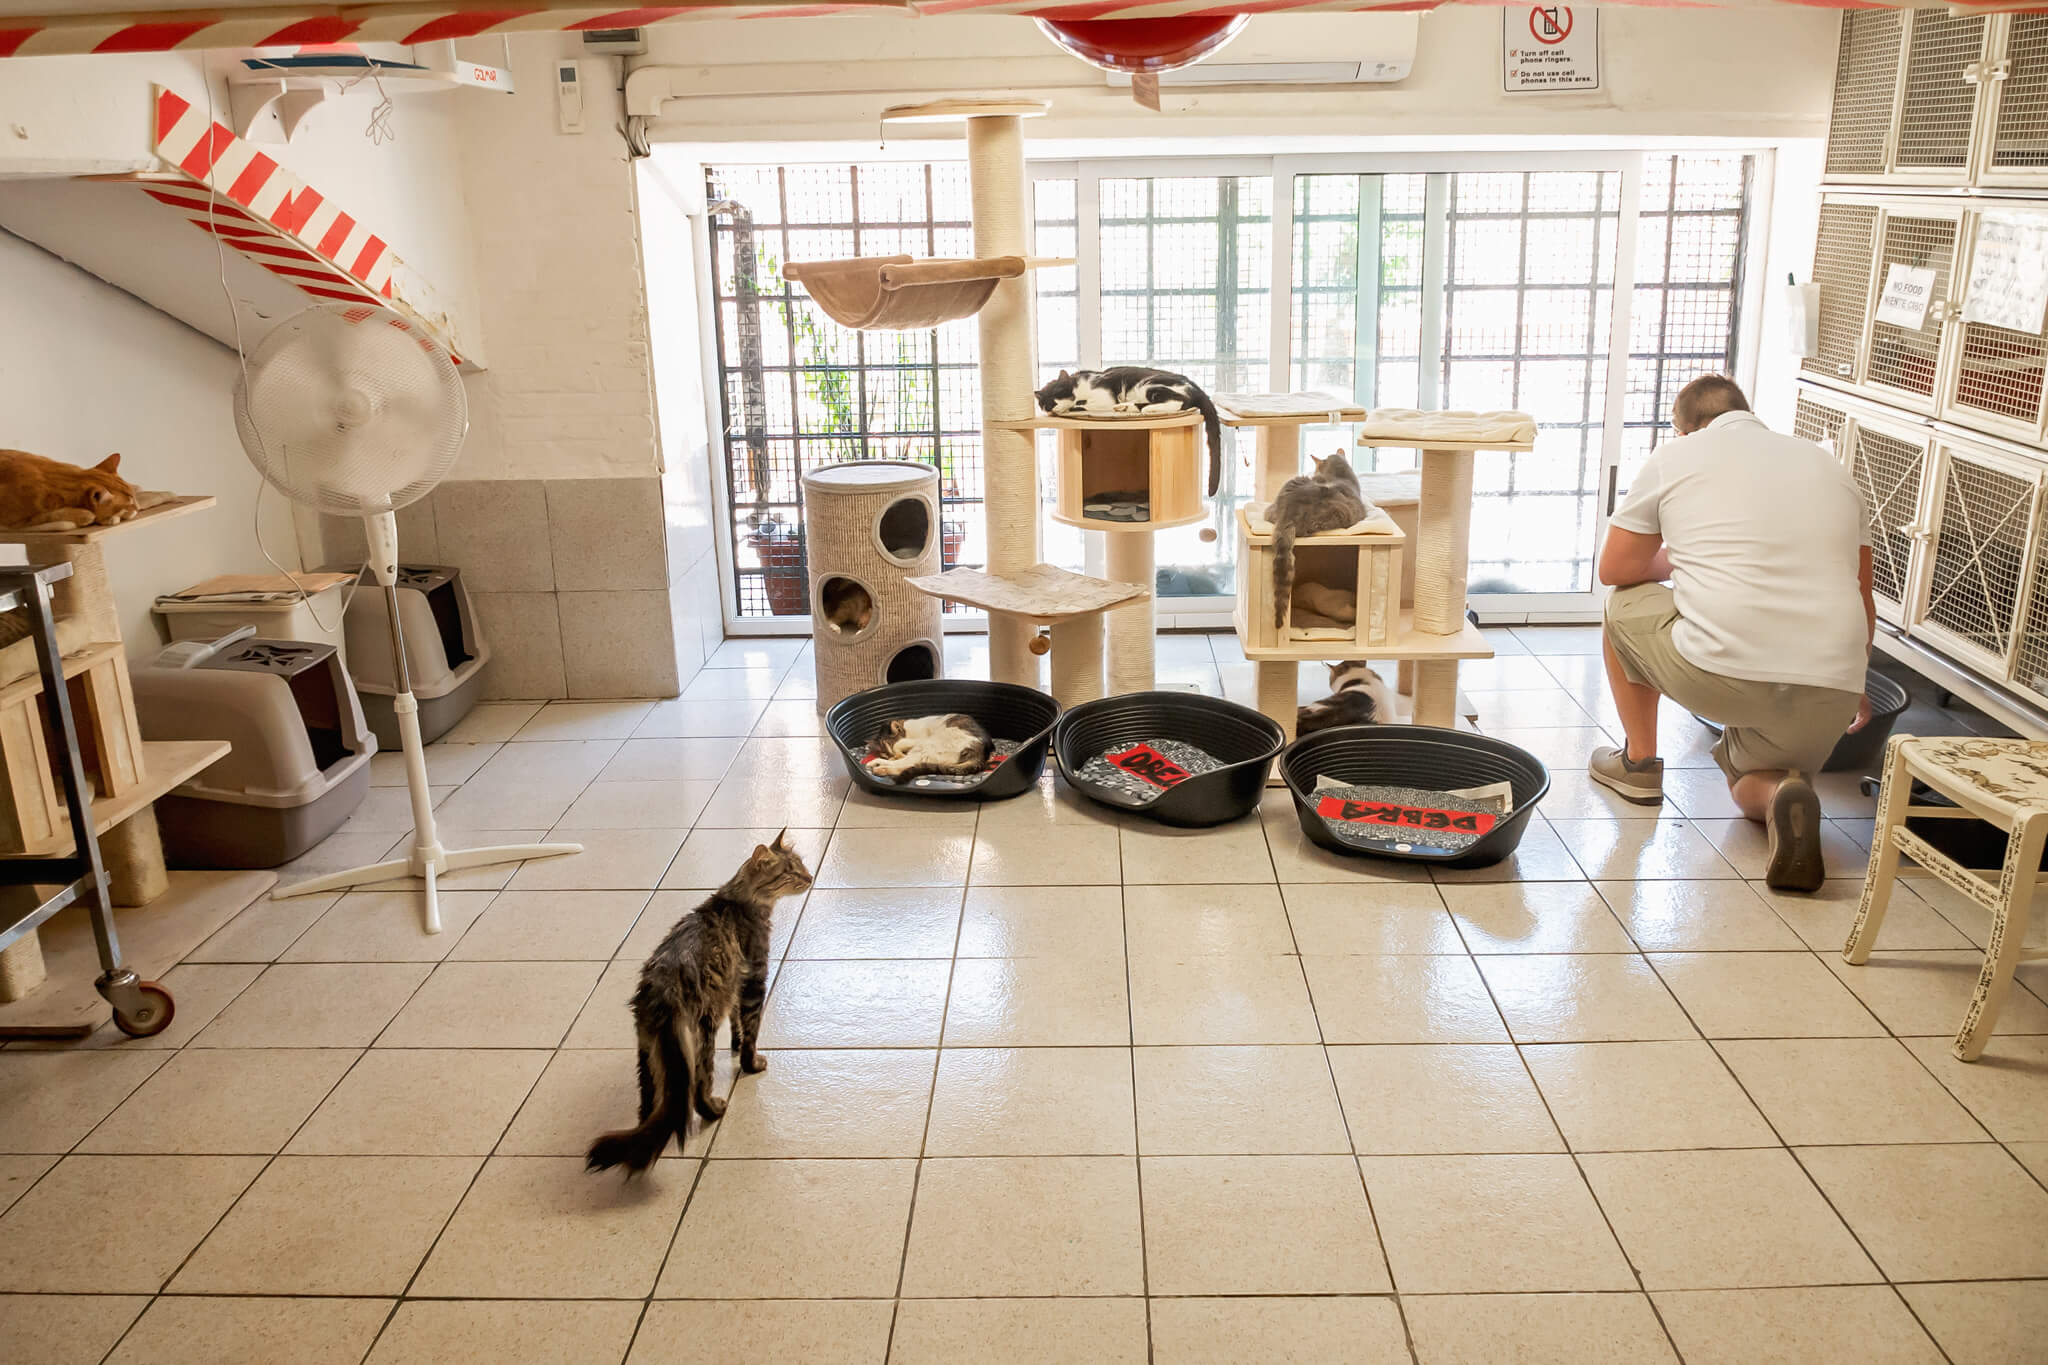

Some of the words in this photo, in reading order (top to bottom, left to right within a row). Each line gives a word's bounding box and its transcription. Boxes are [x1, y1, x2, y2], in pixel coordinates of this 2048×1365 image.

[1894, 282, 1903, 291] NO
[1904, 284, 1923, 295] FOOD
[1340, 800, 1478, 831] DEBRA
